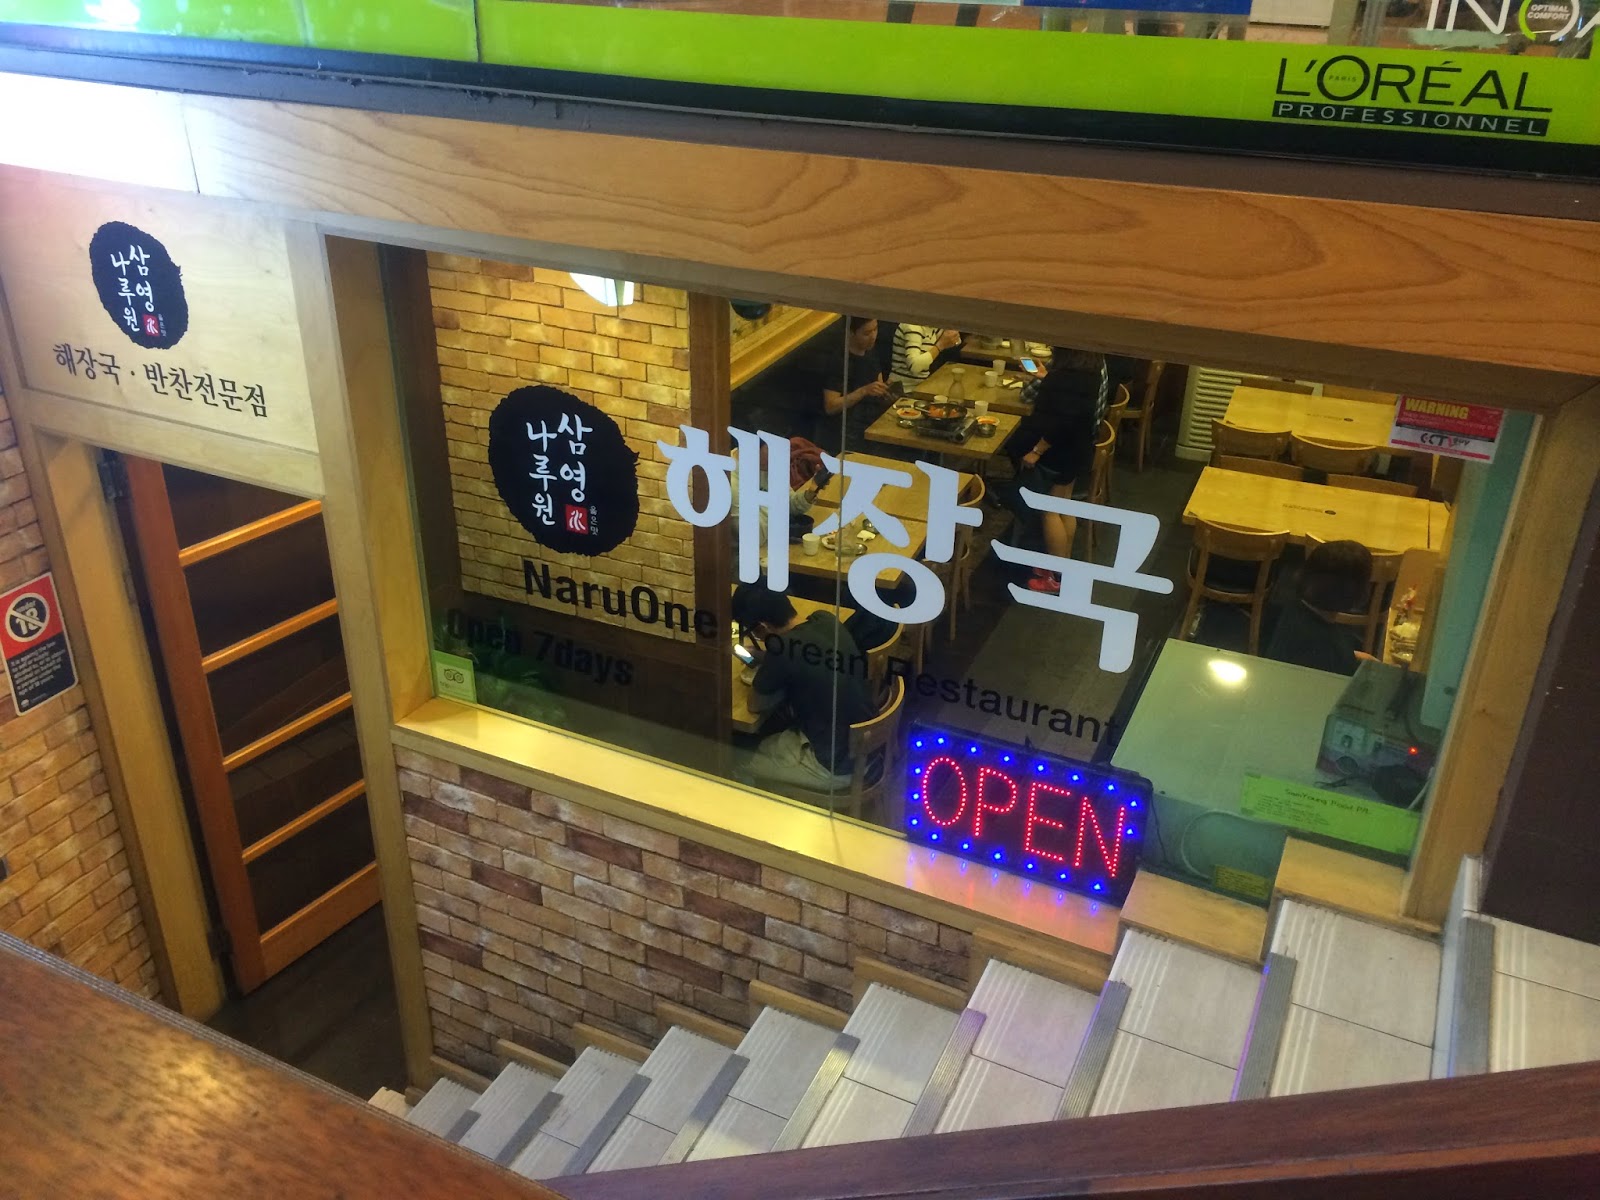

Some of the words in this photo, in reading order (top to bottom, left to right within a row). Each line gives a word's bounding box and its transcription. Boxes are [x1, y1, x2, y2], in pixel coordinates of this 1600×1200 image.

[1527, 11, 1571, 20] COMFORT
[1530, 4, 1569, 13] OPTIMAL
[1275, 55, 1553, 113] L'ORÉAL
[1328, 74, 1357, 83] PARIS
[1277, 103, 1542, 136] PROFESSIONNEL
[52, 343, 121, 385] 해장국
[143, 363, 268, 418] 반찬전문점
[1405, 398, 1470, 420] WARNING
[656, 424, 1174, 675] 해장국
[446, 607, 522, 655] Open
[533, 630, 634, 686] 7days
[523, 559, 719, 640] NaruOne
[738, 617, 869, 680] Korean
[885, 655, 1119, 745] Restaurant
[922, 756, 1126, 879] OPEN
